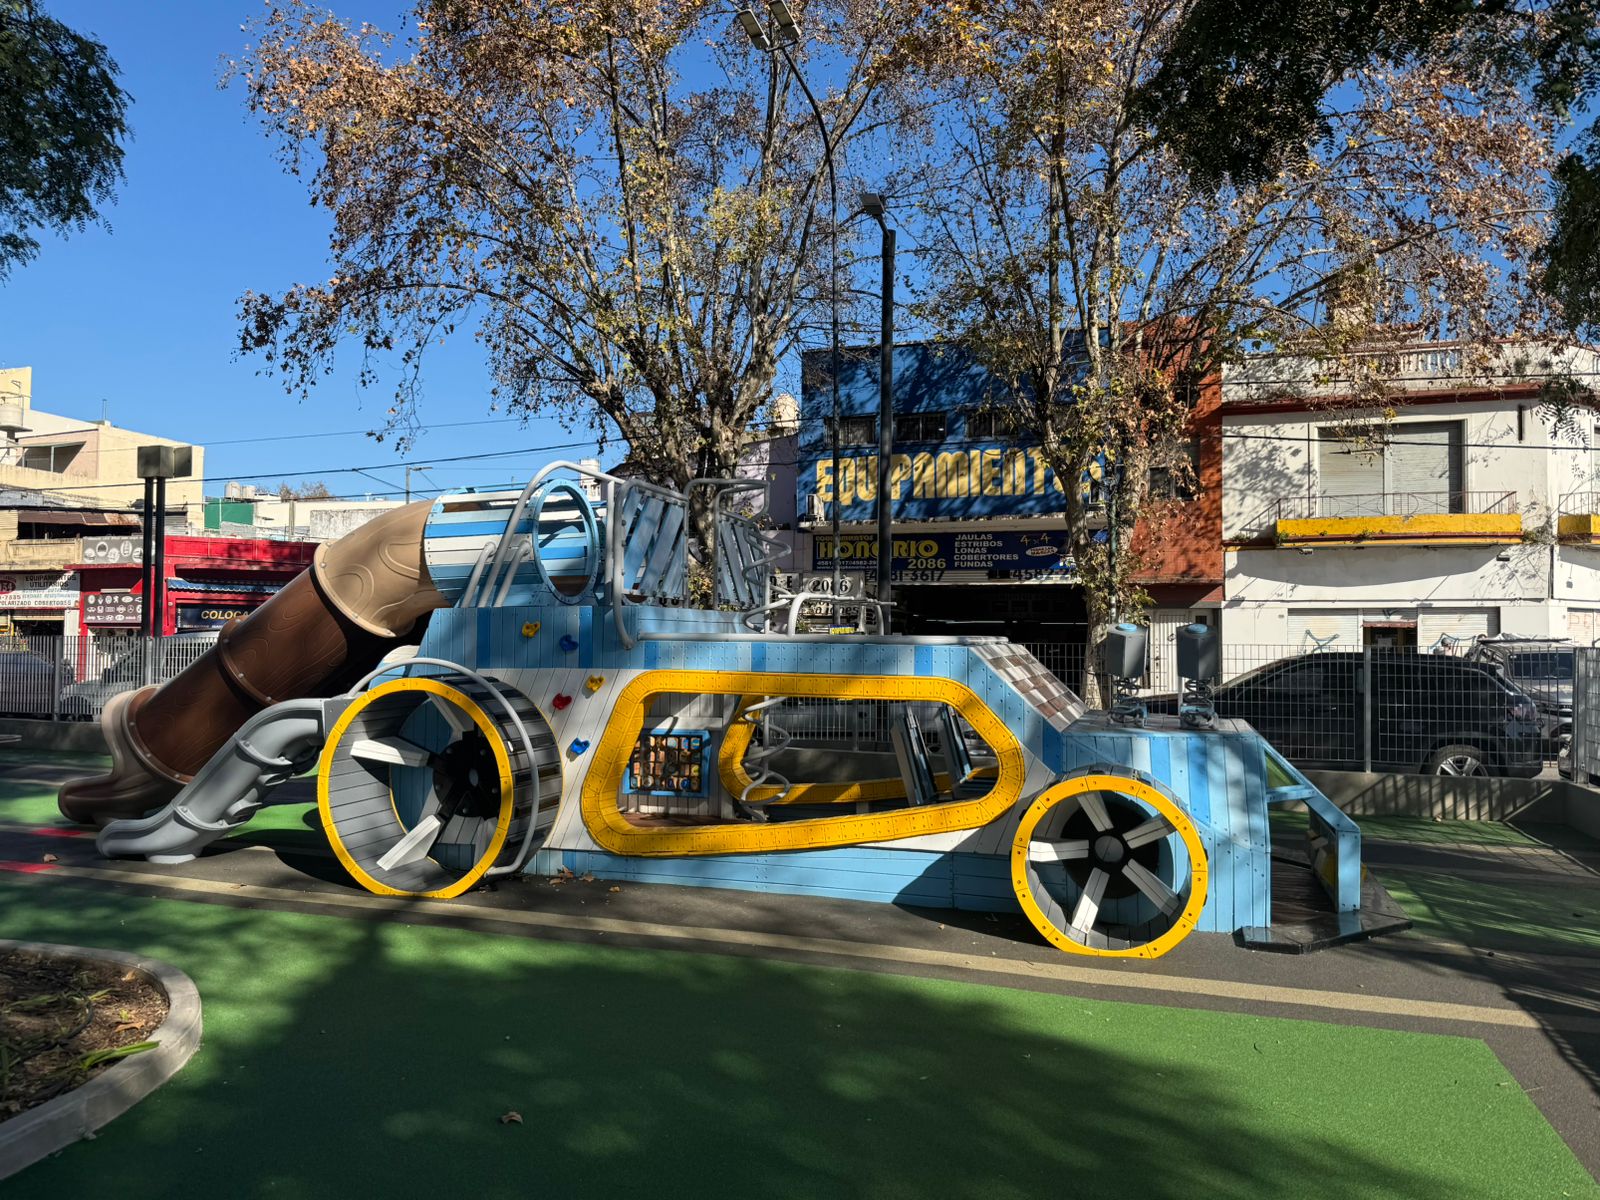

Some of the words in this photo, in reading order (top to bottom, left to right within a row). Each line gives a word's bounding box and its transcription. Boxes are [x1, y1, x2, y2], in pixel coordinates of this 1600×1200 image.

[816, 447, 1102, 506] EQUPAMIENT
[817, 540, 939, 559] HONRIO
[907, 558, 946, 569] 2086
